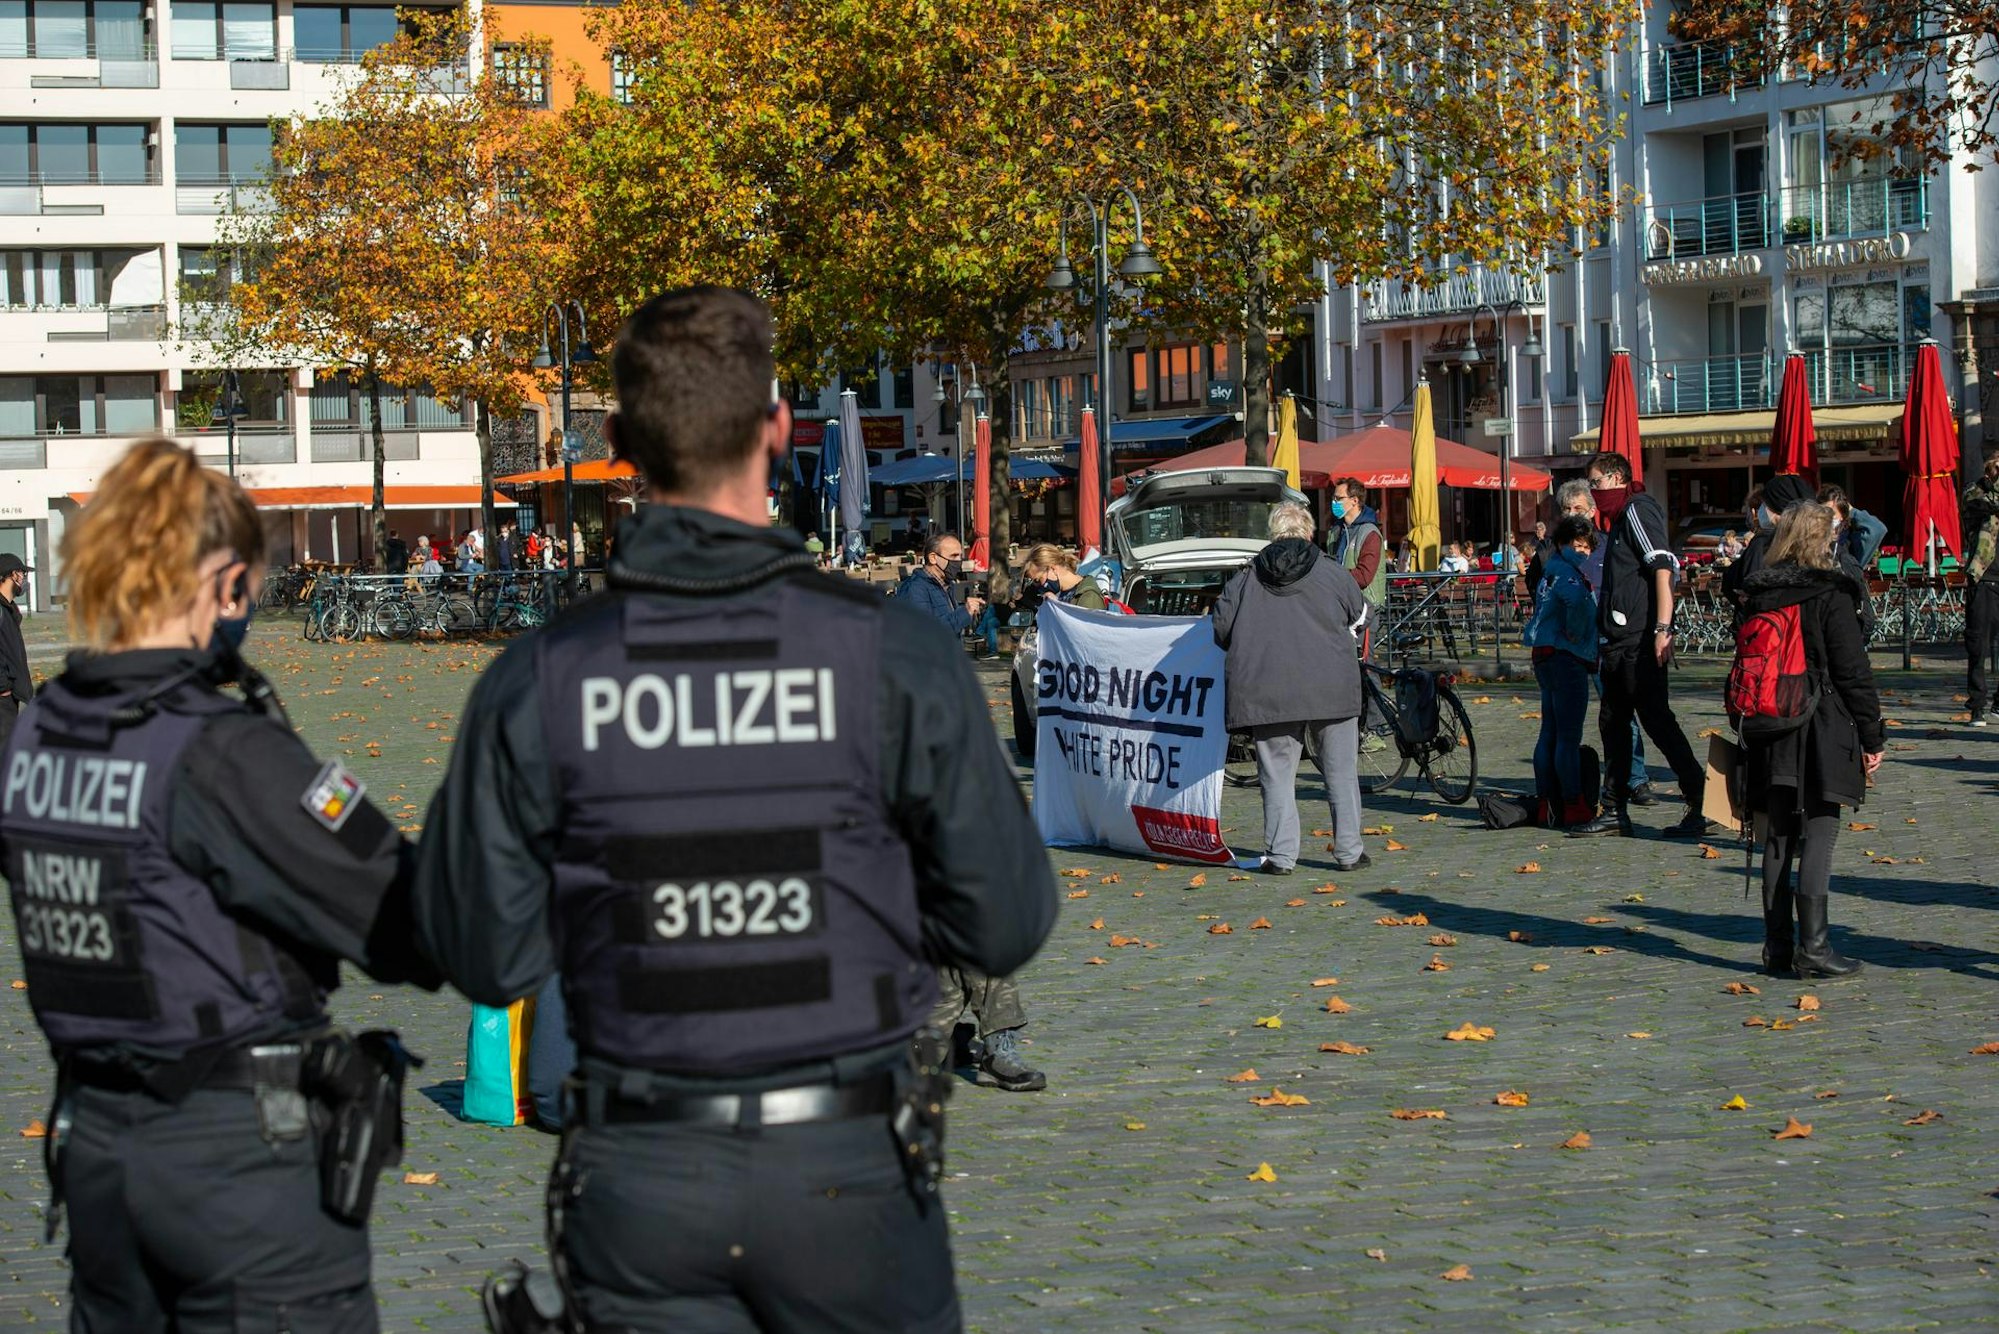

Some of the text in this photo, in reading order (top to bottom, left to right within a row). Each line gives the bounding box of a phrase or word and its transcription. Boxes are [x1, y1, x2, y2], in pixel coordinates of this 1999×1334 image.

[1210, 385, 1233, 400] sky
[581, 667, 837, 752] POLIZEI
[1038, 659, 1215, 718] GOOD NIGHT
[3, 750, 147, 829] POLIZEI
[1109, 738, 1182, 789] PRIDE
[22, 850, 101, 906] NRW
[653, 877, 813, 938] 31323
[22, 902, 114, 961] 31323
